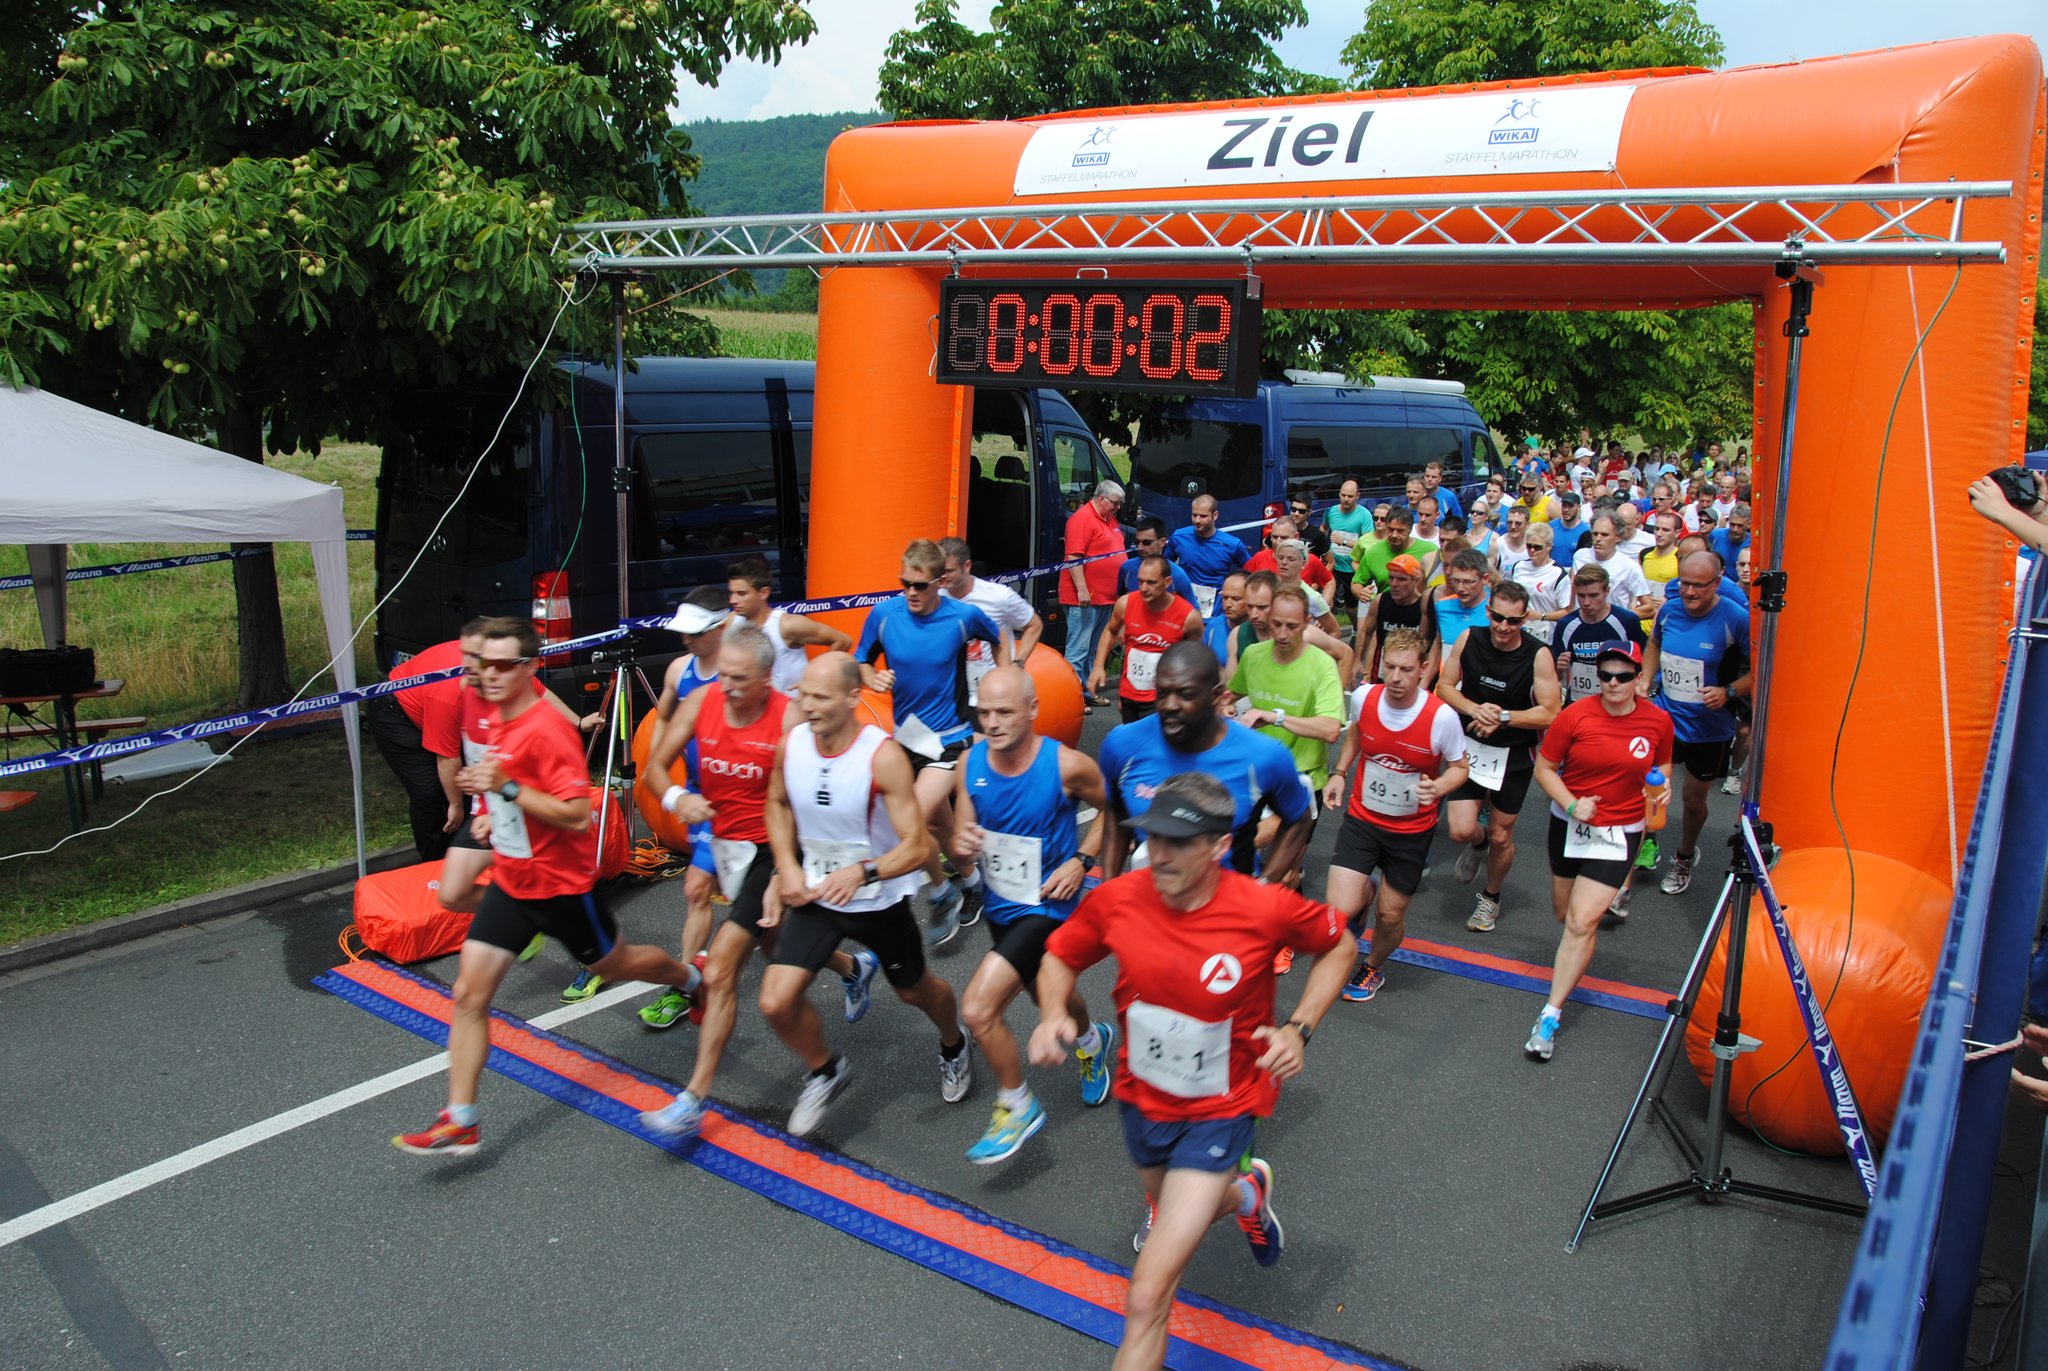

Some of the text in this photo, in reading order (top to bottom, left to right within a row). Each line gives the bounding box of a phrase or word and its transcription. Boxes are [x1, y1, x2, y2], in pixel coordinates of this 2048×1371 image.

[1206, 110, 1375, 170] Ziel
[1493, 130, 1530, 142] WIKA
[1445, 148, 1579, 164] STAFFELMARATHON
[1040, 169, 1138, 184] STAFFELMARATHON
[1132, 663, 1144, 677] 35
[1663, 668, 1681, 685] 130
[1694, 676, 1700, 688] 1
[1573, 676, 1592, 690] 150
[1492, 758, 1498, 773] 1
[1369, 780, 1387, 797] 49
[1403, 789, 1411, 802] 1
[1575, 823, 1592, 839] 44
[1607, 825, 1615, 842] 1
[1020, 860, 1028, 880] 1
[1148, 1036, 1163, 1060] 8
[1192, 1050, 1204, 1072] 1
